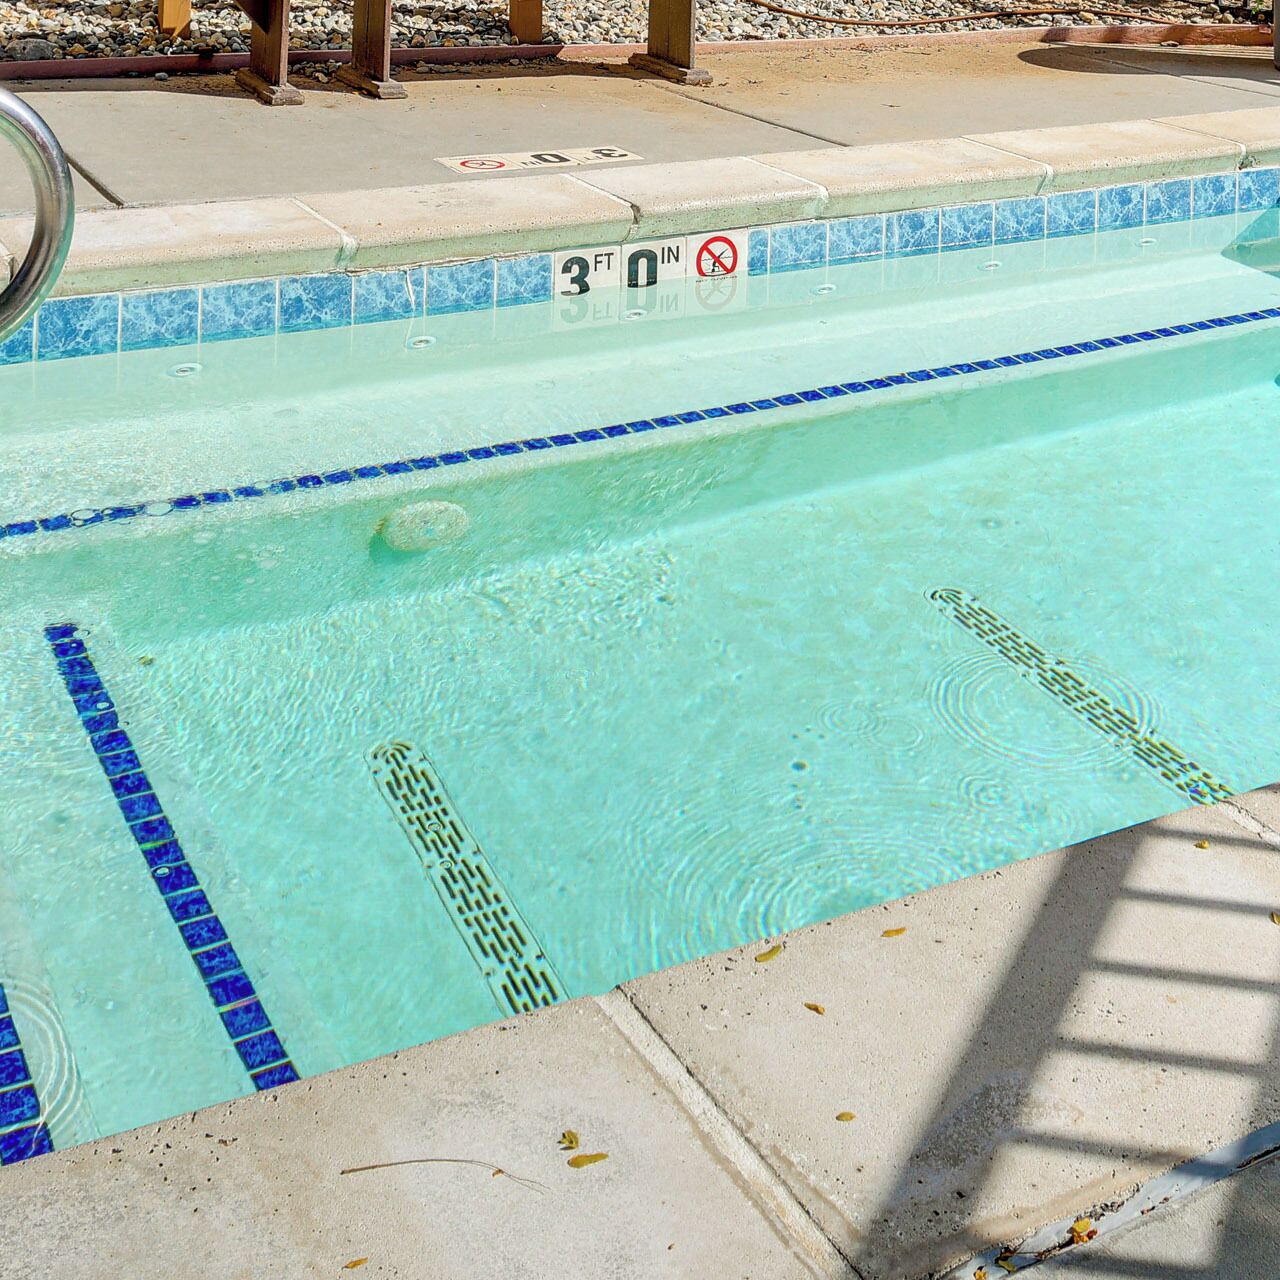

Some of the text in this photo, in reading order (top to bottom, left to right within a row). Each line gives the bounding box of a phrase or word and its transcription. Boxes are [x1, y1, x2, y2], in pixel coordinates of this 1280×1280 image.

[560, 245, 680, 297] 3 FT 0 IN
